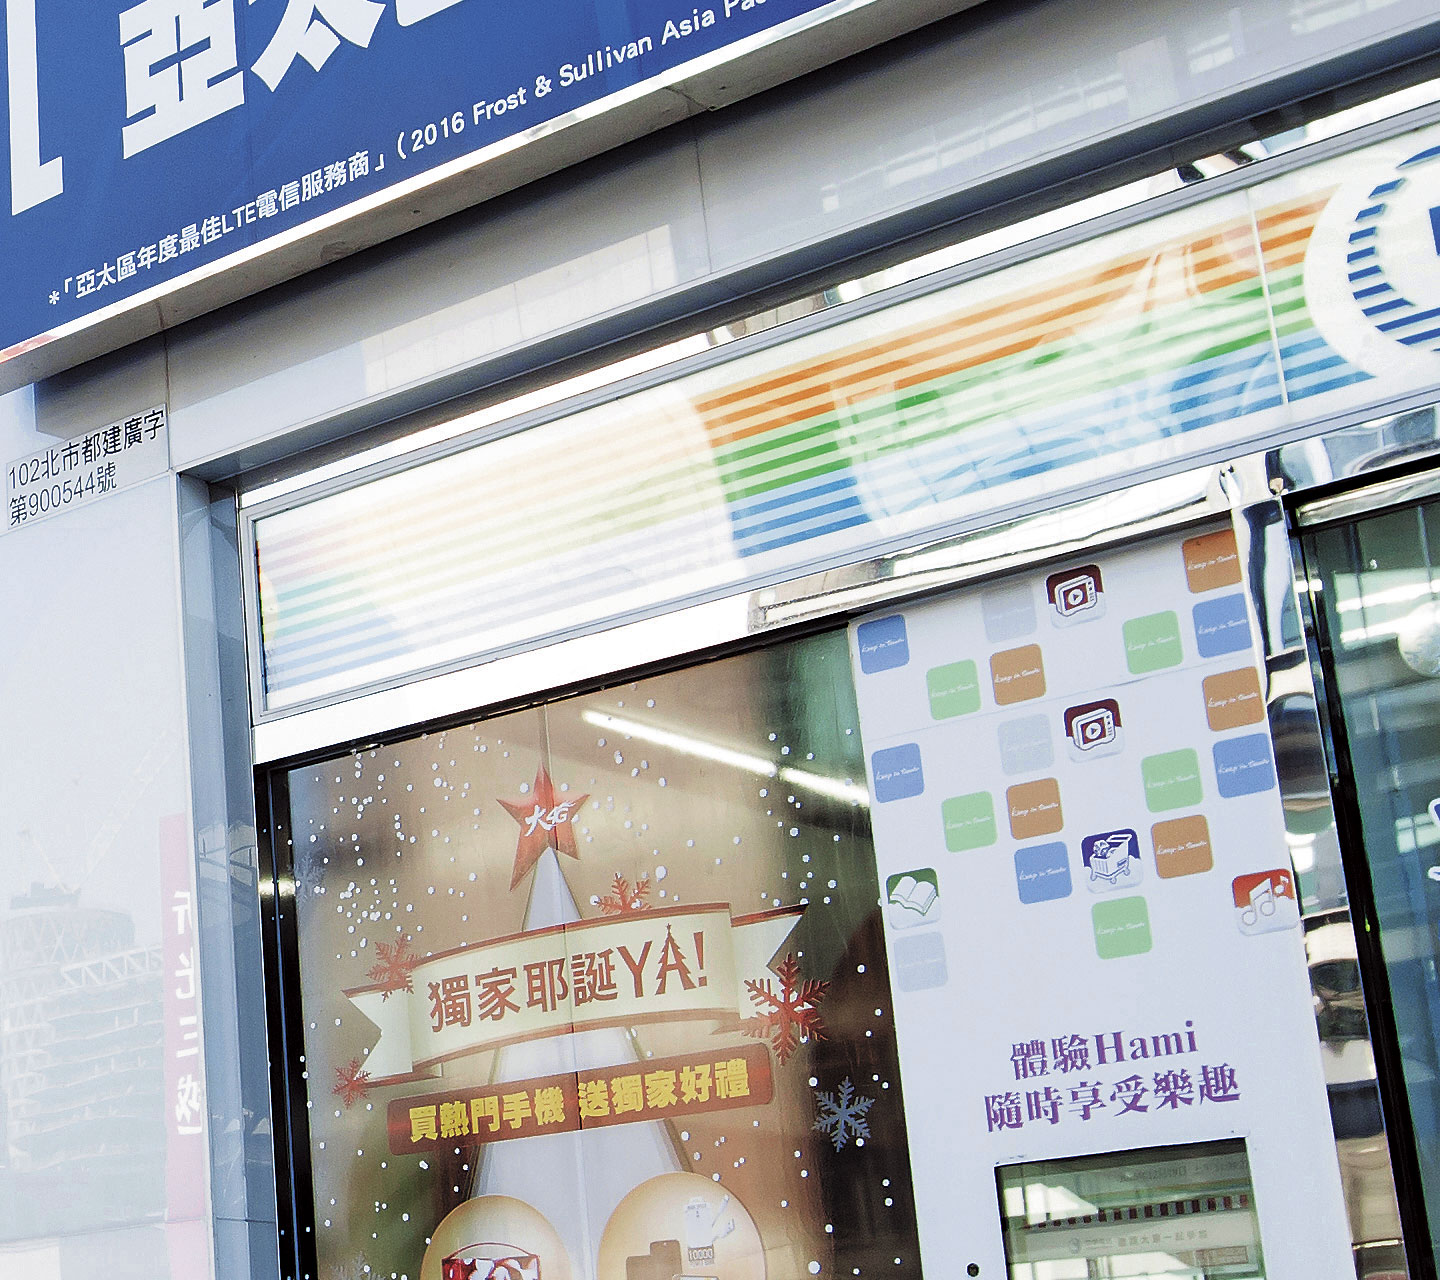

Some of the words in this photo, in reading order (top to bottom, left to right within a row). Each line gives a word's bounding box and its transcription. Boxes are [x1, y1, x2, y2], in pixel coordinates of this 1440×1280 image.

[471, 84, 528, 132] Frost
[534, 74, 553, 98] &
[557, 34, 655, 90] Sullivan
[660, 7, 717, 48] Asia
[8, 409, 167, 490] 102北市都建廣字
[8, 461, 118, 527] 第900544號
[427, 923, 708, 1034] 獨家耶誕YA!
[1009, 1020, 1199, 1083] 體驗Hami
[408, 1087, 567, 1143] 買熱門手機
[577, 1058, 752, 1120] 送獨家好禮
[982, 1061, 1243, 1134] 隨時享受樂趣
